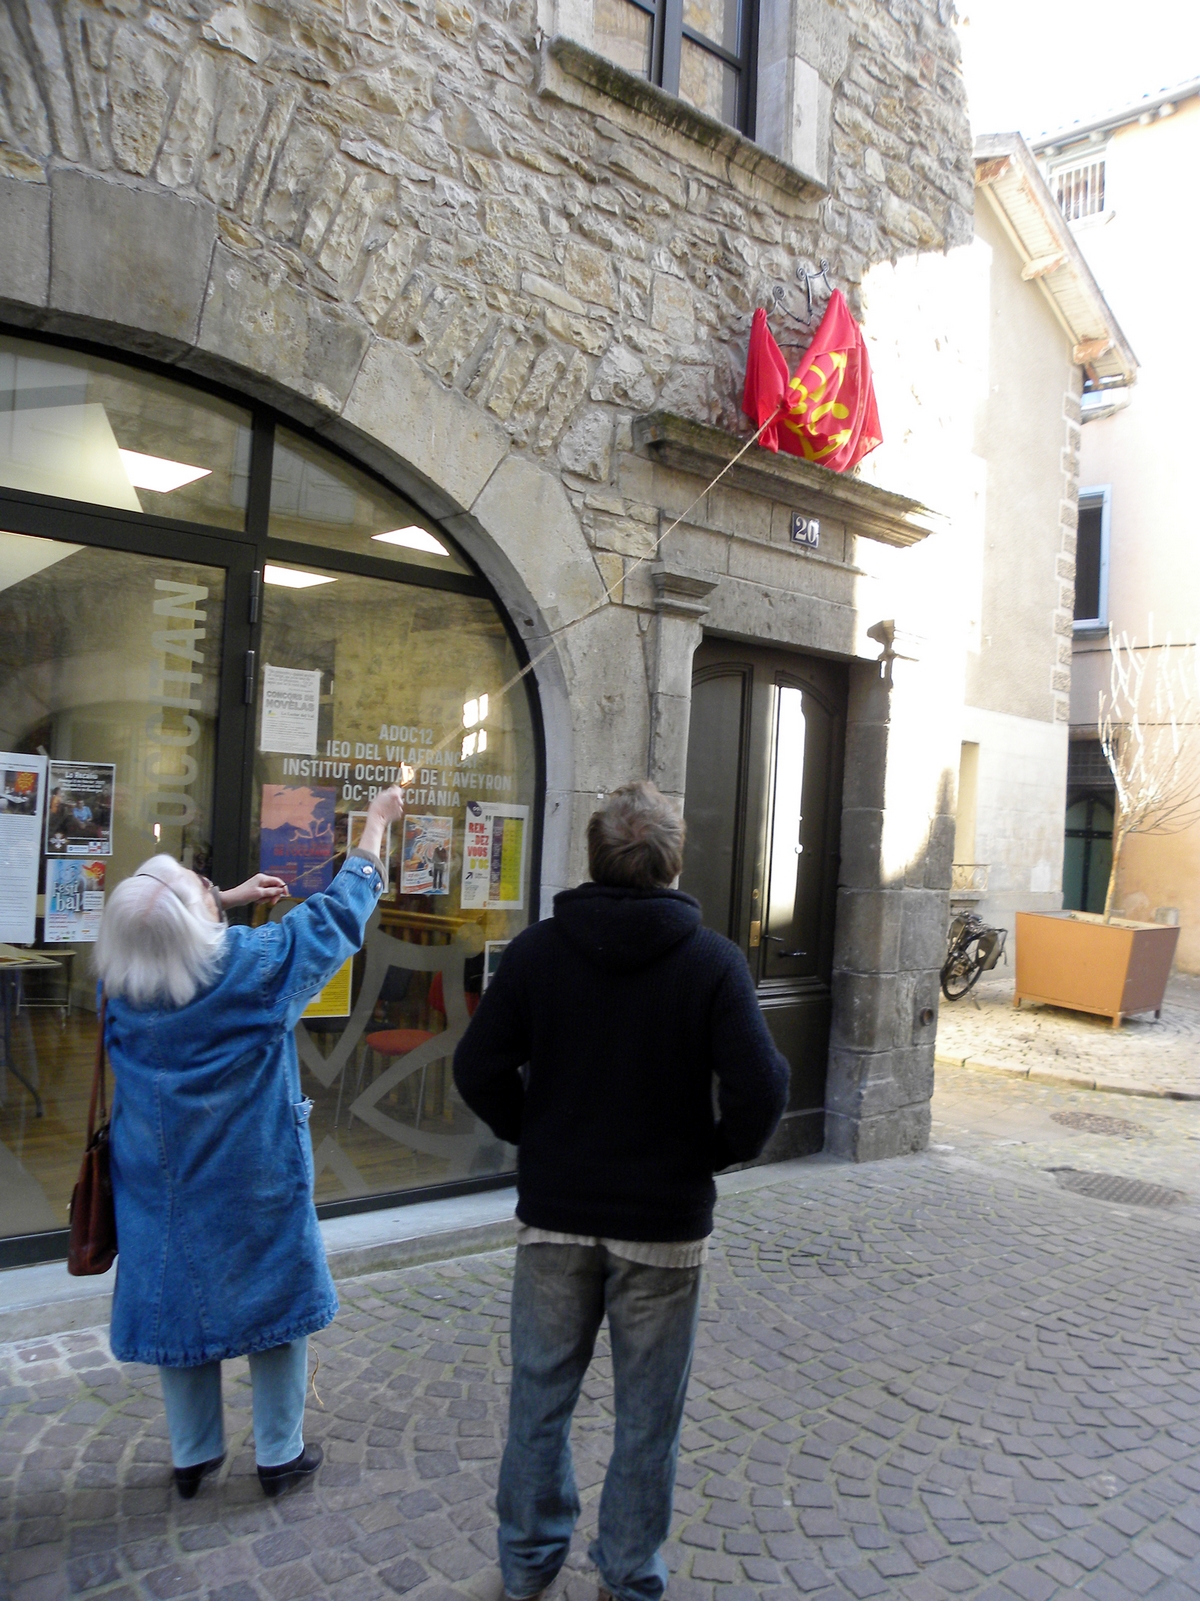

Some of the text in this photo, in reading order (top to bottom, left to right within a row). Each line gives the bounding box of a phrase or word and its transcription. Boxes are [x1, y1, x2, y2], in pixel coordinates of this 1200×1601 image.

[795, 516, 819, 543] 20
[379, 724, 433, 745] ADOC12
[326, 740, 351, 758] IEO
[355, 742, 381, 761] DEL
[283, 758, 351, 780] INSTITUT
[420, 768, 438, 786] DE
[441, 770, 512, 791] L'AVEYRON
[467, 846, 488, 857] VOUS
[56, 892, 81, 912] bal
